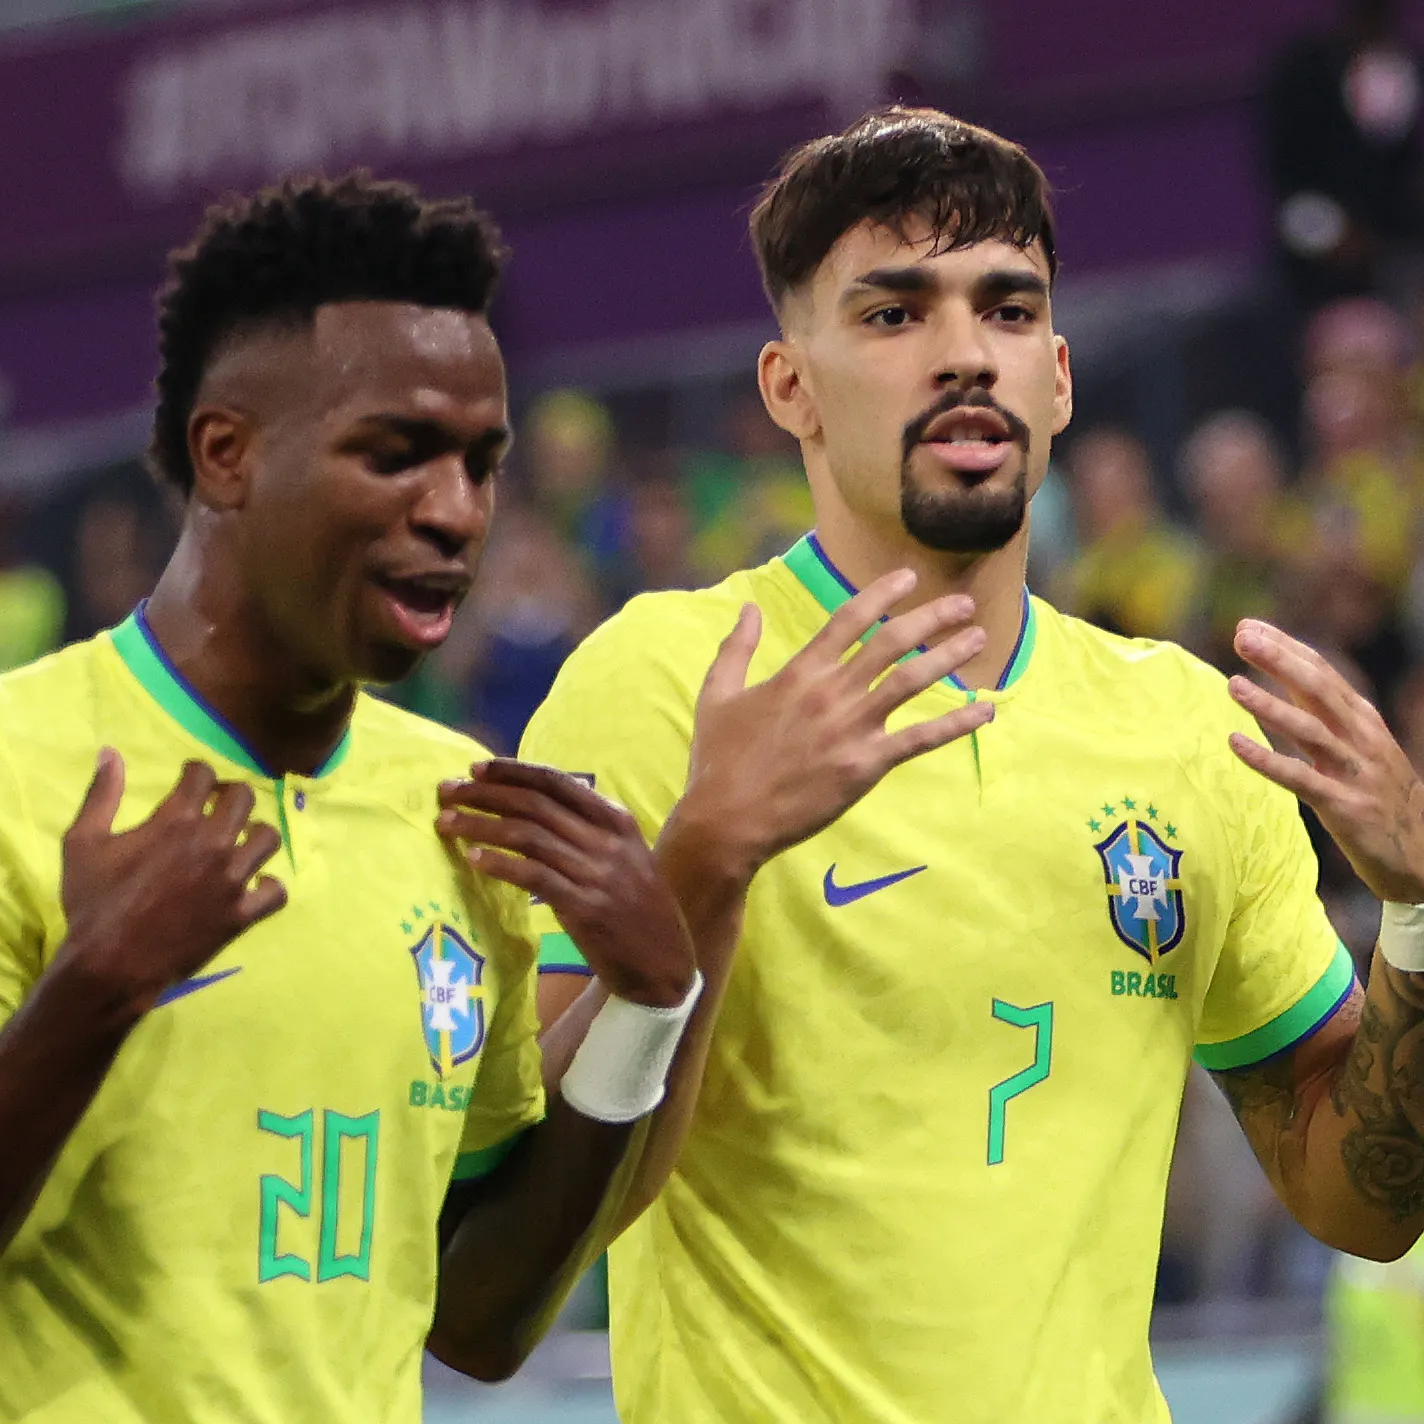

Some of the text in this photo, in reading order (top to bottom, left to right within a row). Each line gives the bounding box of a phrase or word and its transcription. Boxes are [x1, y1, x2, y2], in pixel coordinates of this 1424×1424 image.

[1129, 878, 1158, 896] CBF
[430, 985, 457, 1004] CBF
[1110, 970, 1179, 1000] BRASIL
[987, 998, 1053, 1166] 7
[257, 1107, 381, 1284] 20
